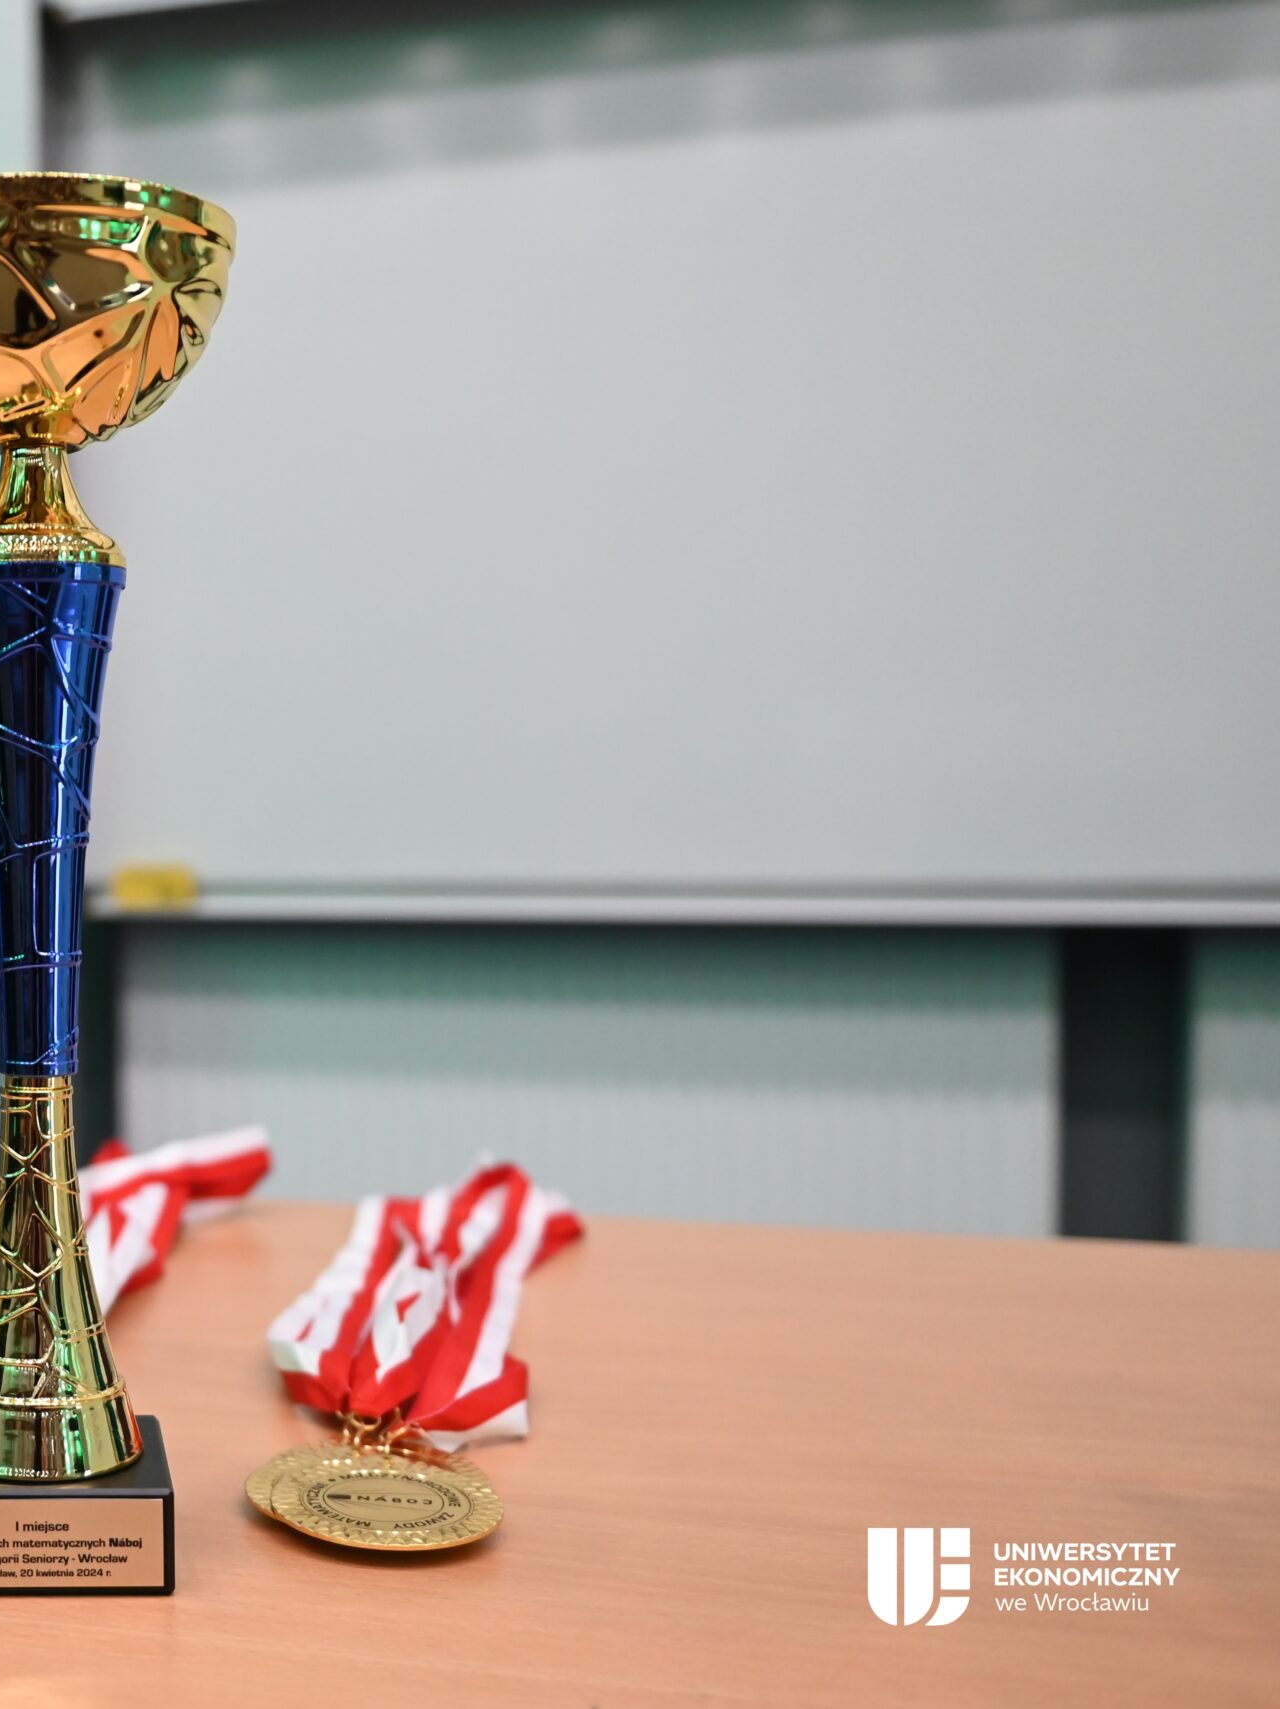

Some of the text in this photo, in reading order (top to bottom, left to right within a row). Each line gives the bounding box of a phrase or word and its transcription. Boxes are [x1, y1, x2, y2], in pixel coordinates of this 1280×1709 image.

[15, 1521, 69, 1533] I miejsce
[12, 1539, 106, 1550] matematycznych
[109, 1538, 142, 1549] Náboj
[22, 1554, 69, 1566] Seniorzy
[78, 1554, 128, 1563] Wrocław
[20, 1569, 33, 1577] 20
[36, 1569, 74, 1577] kwietnia
[76, 1569, 103, 1577] 2024
